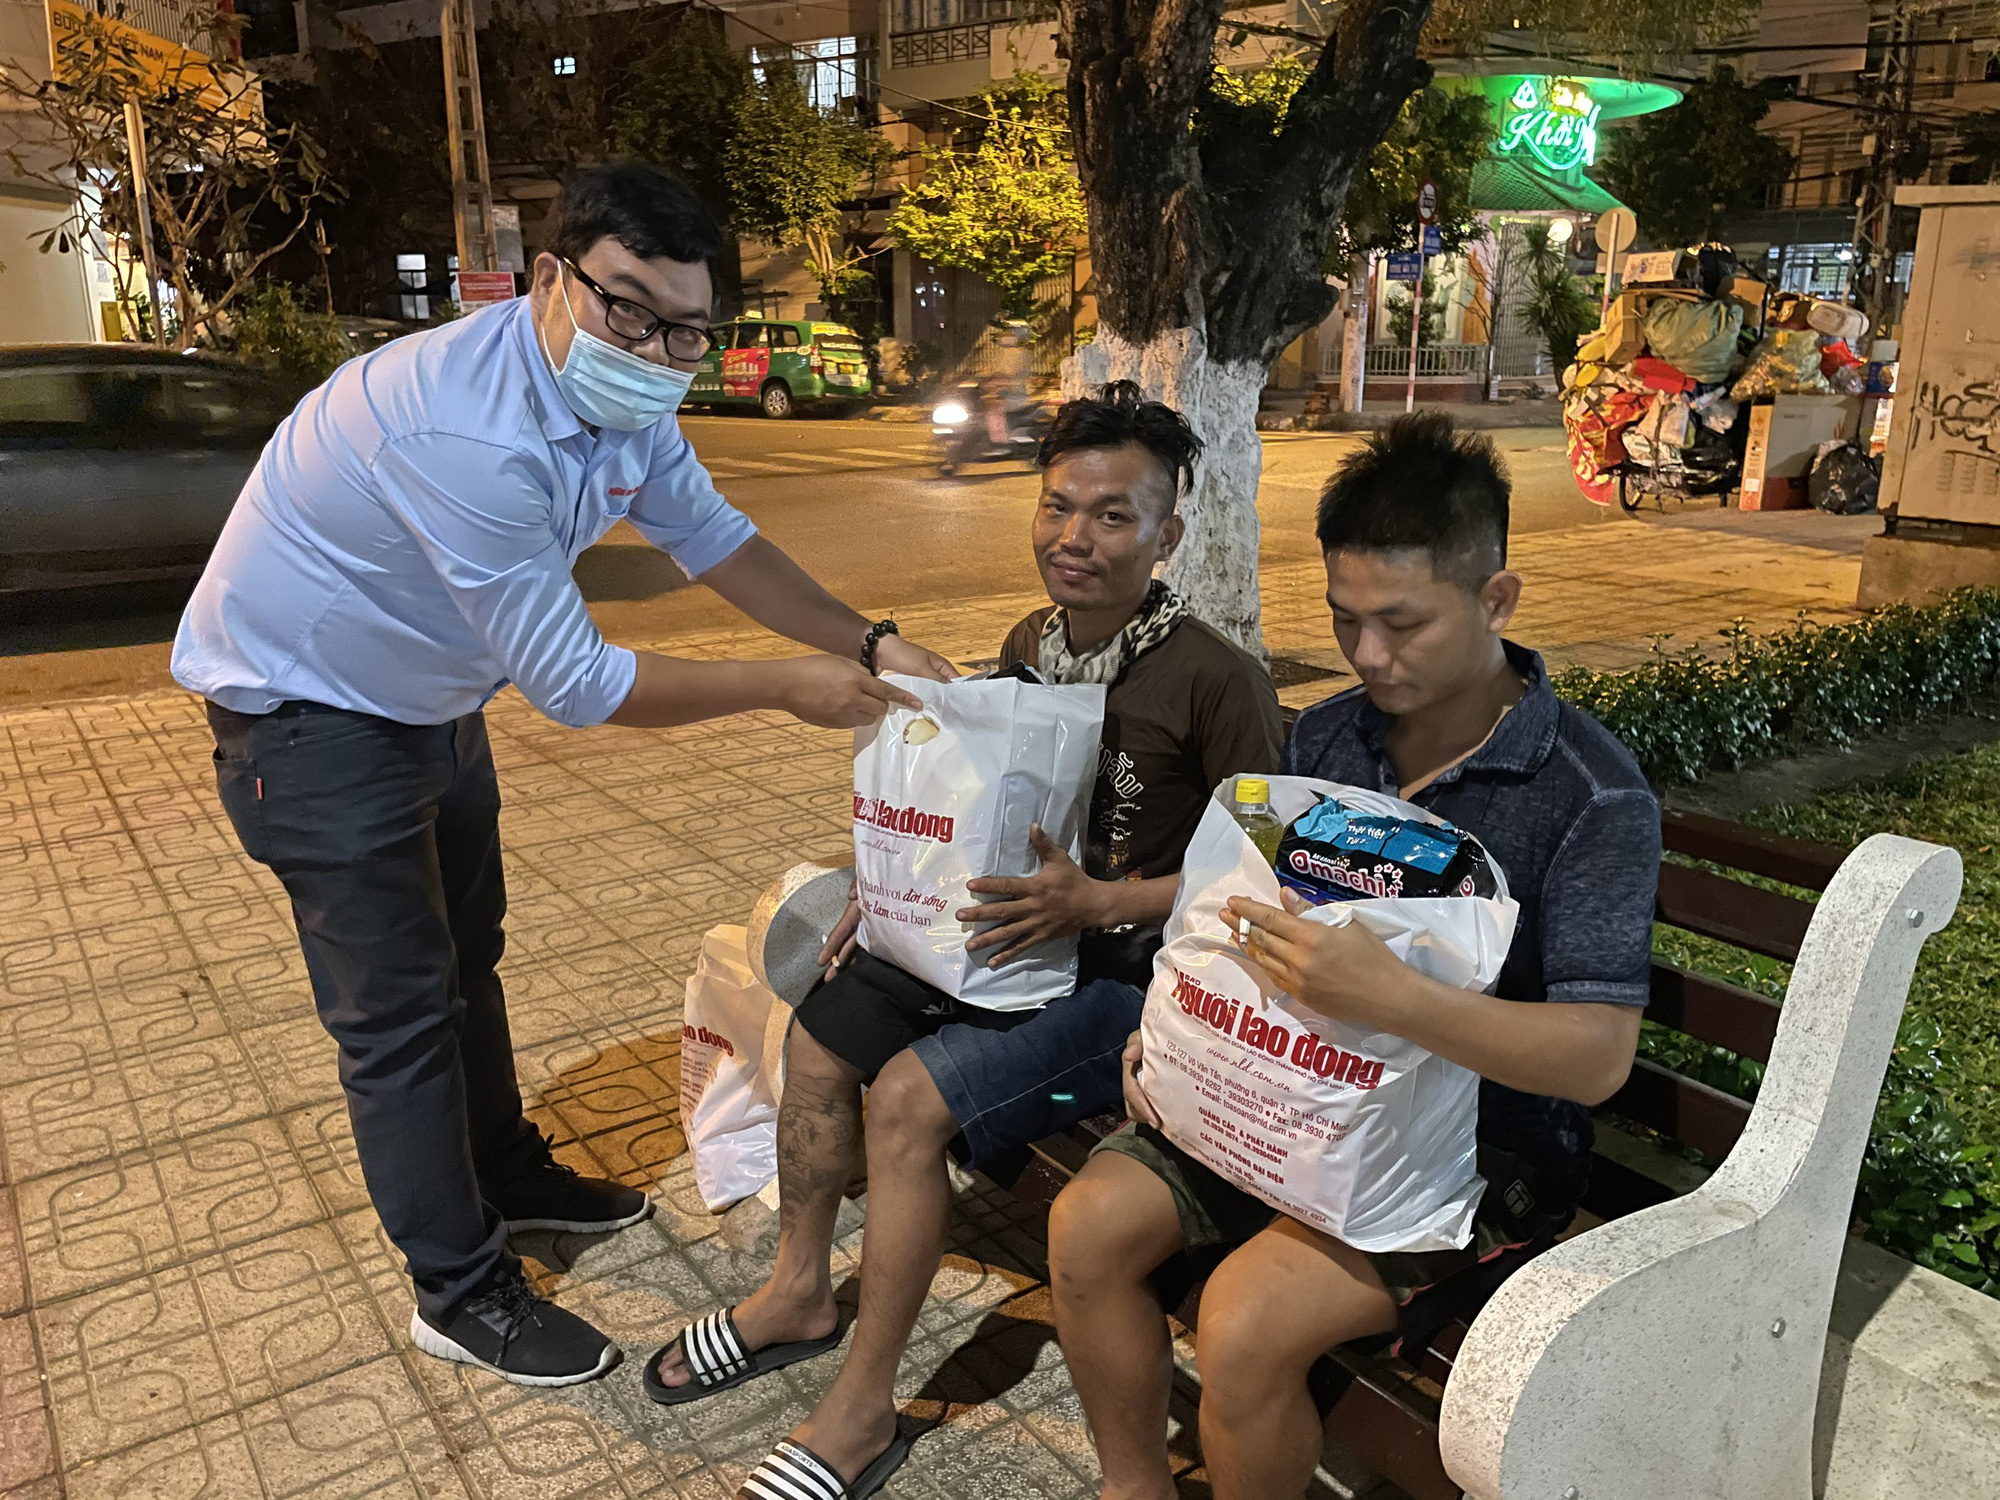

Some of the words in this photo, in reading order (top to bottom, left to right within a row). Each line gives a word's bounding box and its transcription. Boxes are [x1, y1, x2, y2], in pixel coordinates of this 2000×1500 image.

[899, 806, 954, 843] động
[1289, 849, 1385, 898] Omachi
[890, 910, 908, 923] của
[911, 909, 932, 928] bạn
[922, 894, 948, 913] sống
[1170, 967, 1240, 1036] Người
[1237, 1004, 1291, 1058] lao
[1290, 1032, 1386, 1091] động
[1166, 1040, 1188, 1060] 123-127
[1260, 1096, 1279, 1109] quận
[1289, 1107, 1300, 1117] TP
[1180, 1062, 1204, 1084] 08.3930
[1205, 1078, 1222, 1094] 6262
[1227, 1090, 1264, 1114] 39303270
[1272, 1112, 1290, 1126] Fax:
[1291, 1119, 1324, 1139] 08.3930
[1201, 1087, 1223, 1105] Email:
[1223, 1099, 1297, 1140] toasoan@nld.com.vn
[1200, 1132, 1213, 1145] CÁC
[1228, 1149, 1252, 1168] PHÒNG
[1266, 1171, 1284, 1185] DIỆN
[1222, 1120, 1236, 1133] CÁO
[1239, 1129, 1244, 1138] &
[1246, 1133, 1265, 1148] PHÁT
[1266, 1143, 1288, 1159] HÀNH
